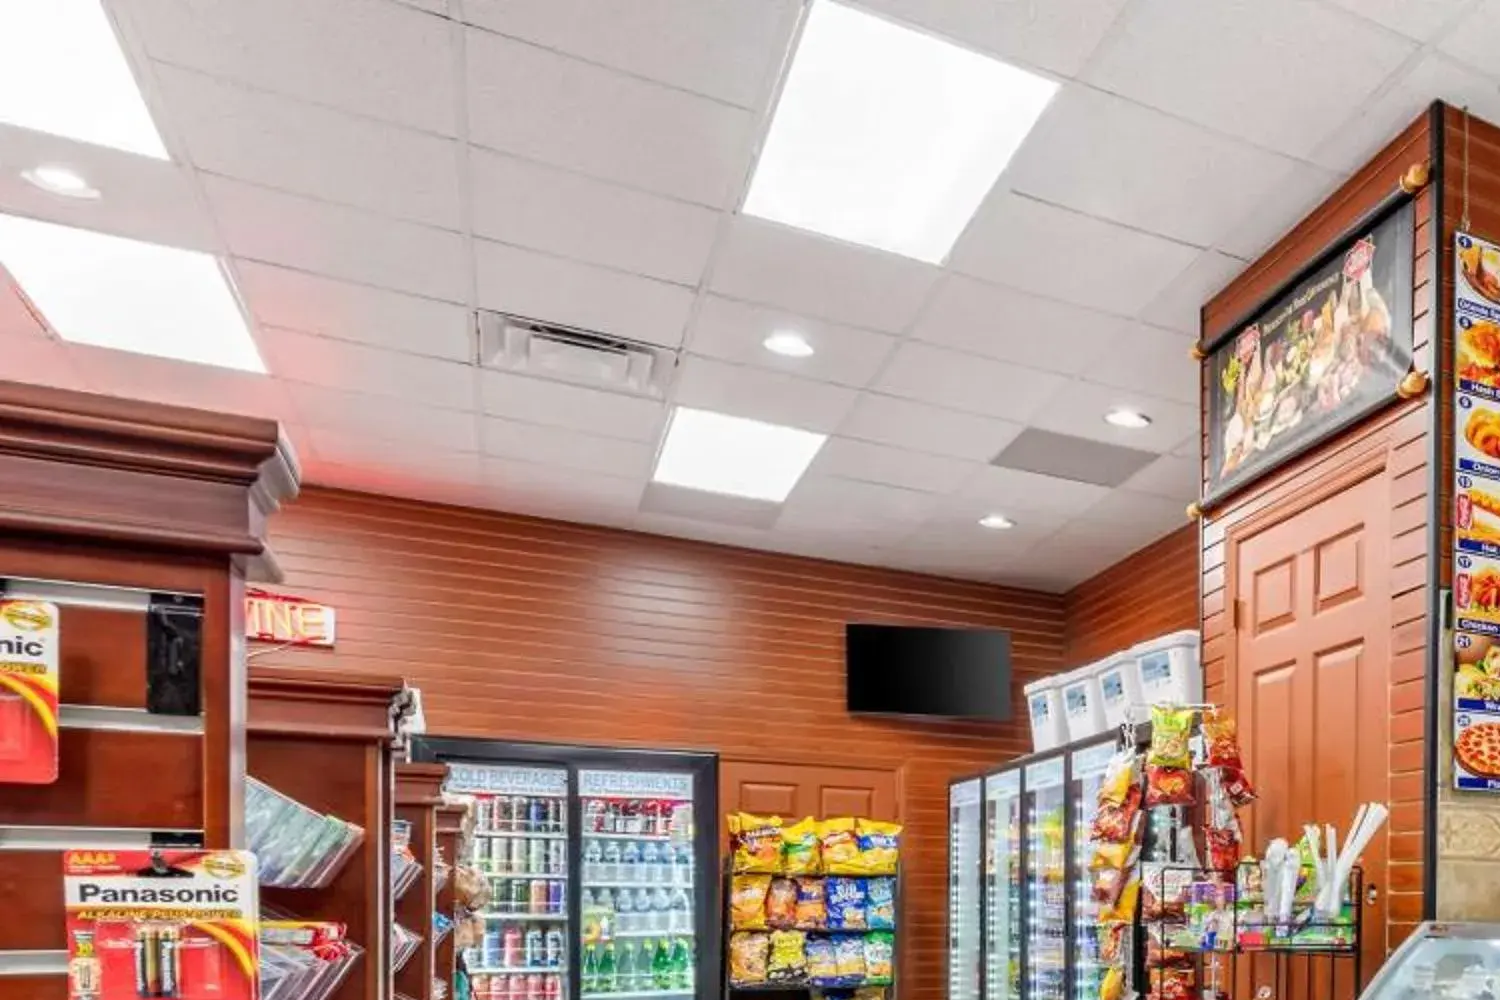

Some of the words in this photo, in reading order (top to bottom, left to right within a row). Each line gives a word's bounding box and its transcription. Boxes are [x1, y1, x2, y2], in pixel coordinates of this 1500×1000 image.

[1472, 462, 1499, 474] Onion
[1482, 544, 1498, 553] Hot
[1461, 620, 1499, 633] Chicken
[79, 884, 239, 903] Panasonic
[77, 909, 147, 921] ALKALINE
